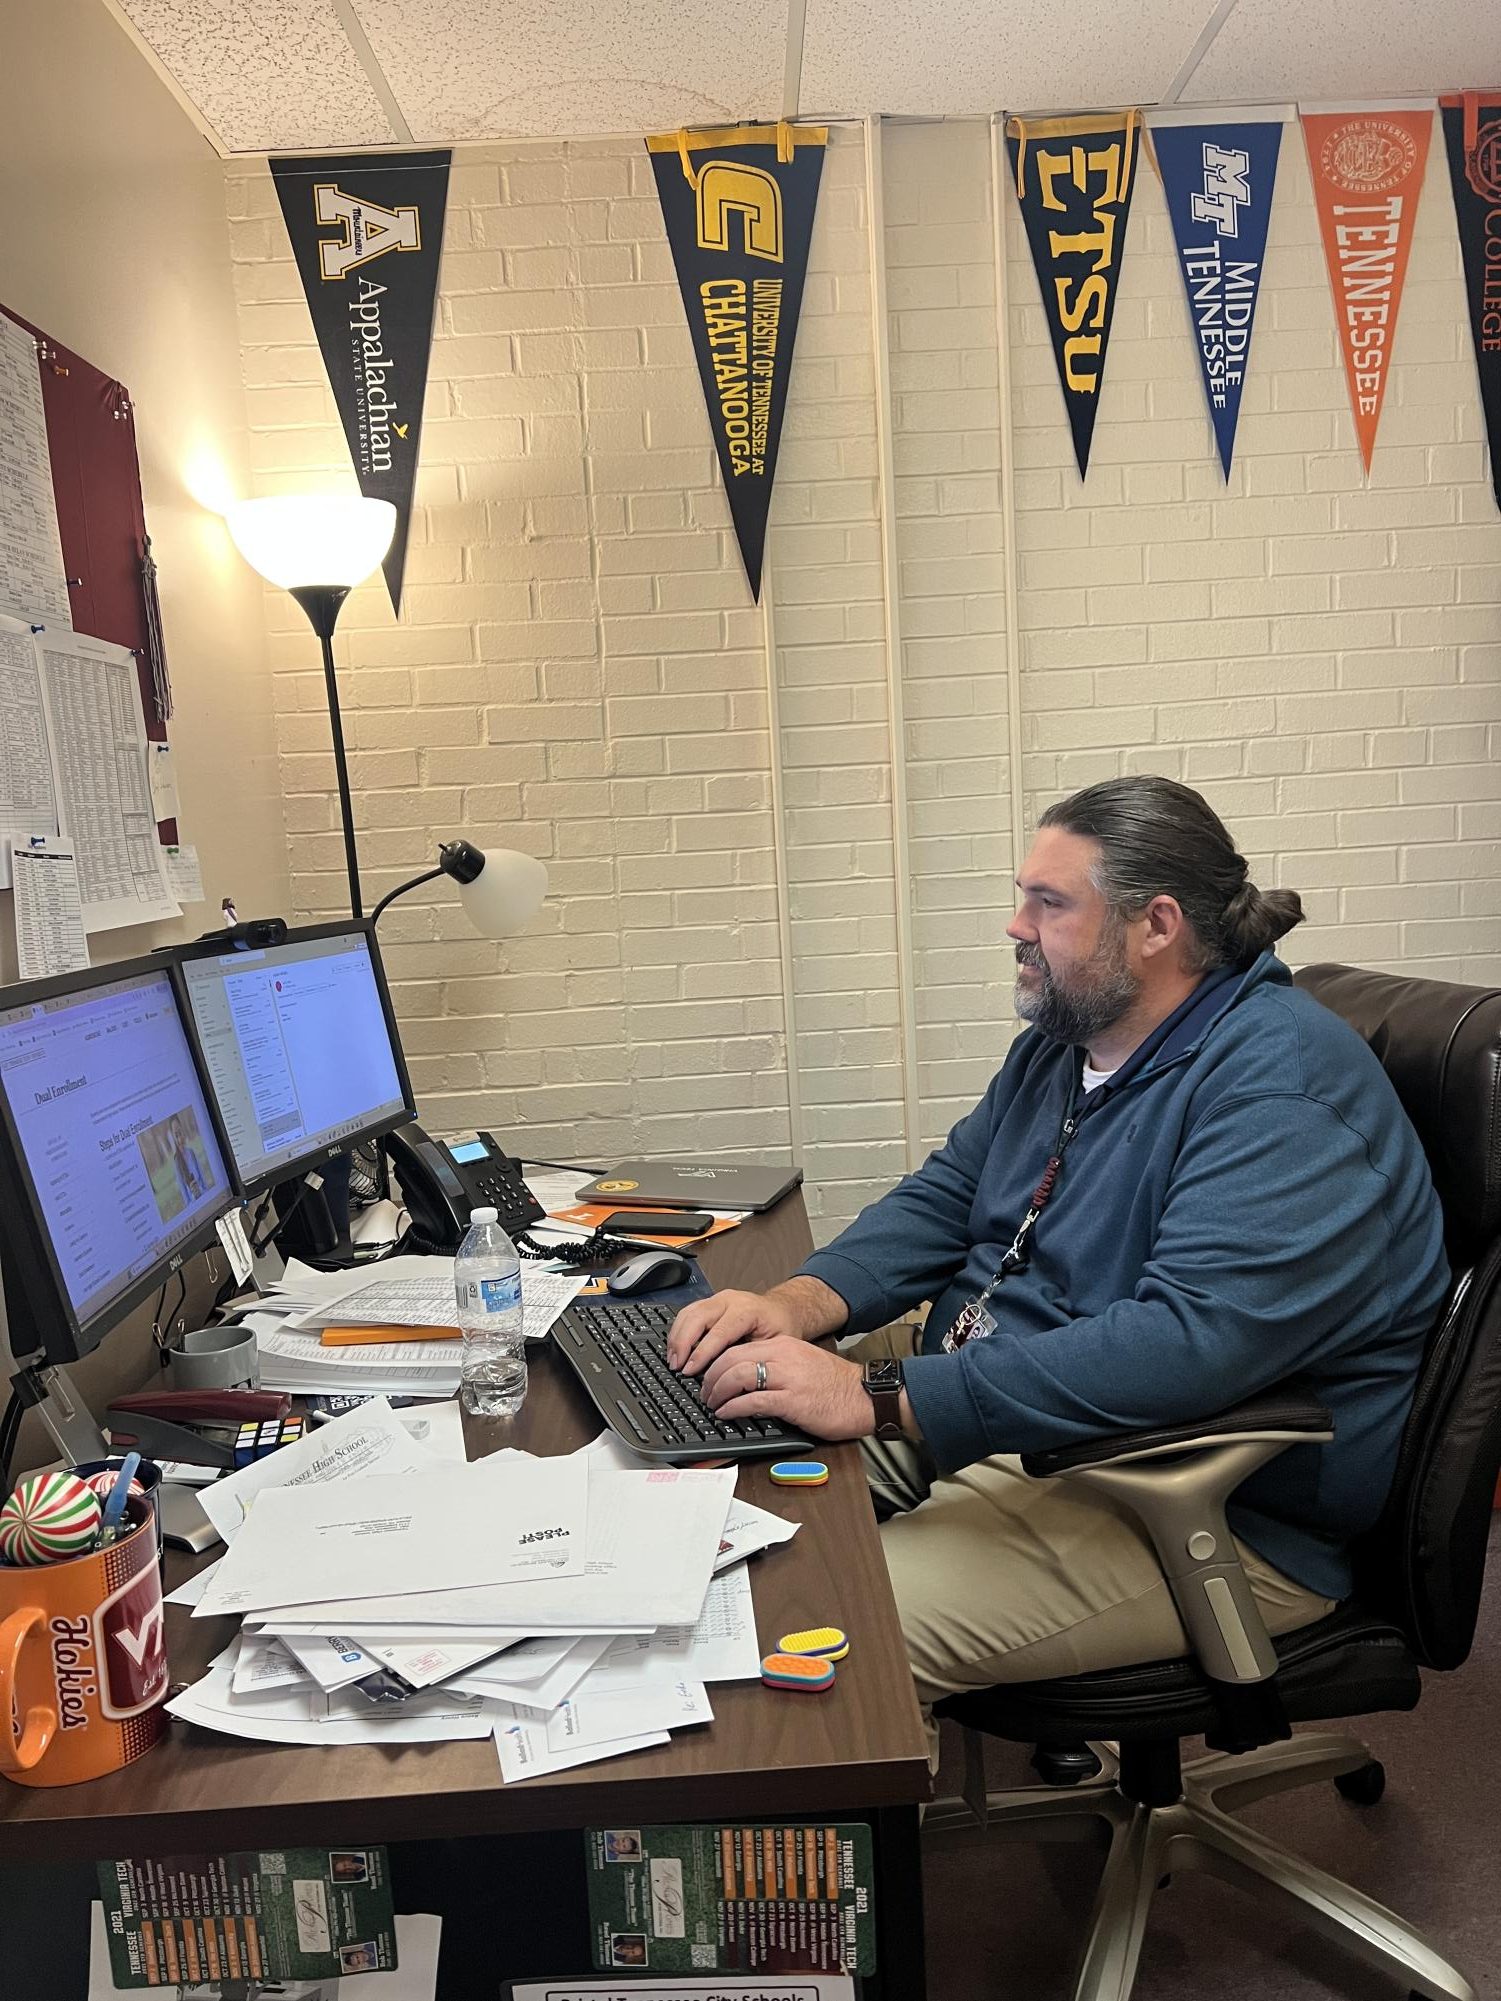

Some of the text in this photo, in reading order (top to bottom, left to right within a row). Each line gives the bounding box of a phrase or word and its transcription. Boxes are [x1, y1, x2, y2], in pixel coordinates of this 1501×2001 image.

[313, 183, 422, 281] A
[696, 160, 785, 264] C
[1035, 143, 1121, 394] ETSU
[1332, 196, 1404, 416] TENNESSEE
[1482, 209, 1501, 352] COLLEGE
[1182, 240, 1227, 408] TENNESSEE
[1225, 261, 1258, 386] MIDDLE
[349, 276, 398, 473] Appalachian
[352, 339, 370, 473] STATE UNIVERSITY
[700, 279, 750, 477] CHATTANOOGA
[751, 279, 783, 475] UNIVERSITY OF TENNESSEE AT
[34, 1075, 88, 1105] Dual Enrollment
[328, 1144, 342, 1157] DELL
[169, 1254, 183, 1271] DELL
[312, 1455, 335, 1473] HIGH
[334, 1436, 370, 1460] SCHOOL
[518, 1531, 570, 1545] PLEASE
[522, 1528, 563, 1540] POST!
[52, 1616, 95, 1730] Hokies
[116, 1862, 133, 1918] VIRGINIA TECH
[843, 1840, 854, 1889] TENNESSEE
[856, 1887, 867, 1914] 2021
[110, 1911, 123, 1934] 2021
[126, 1930, 141, 1975] TENNESSEE
[845, 1905, 857, 1969] VIRGINIA TECH
